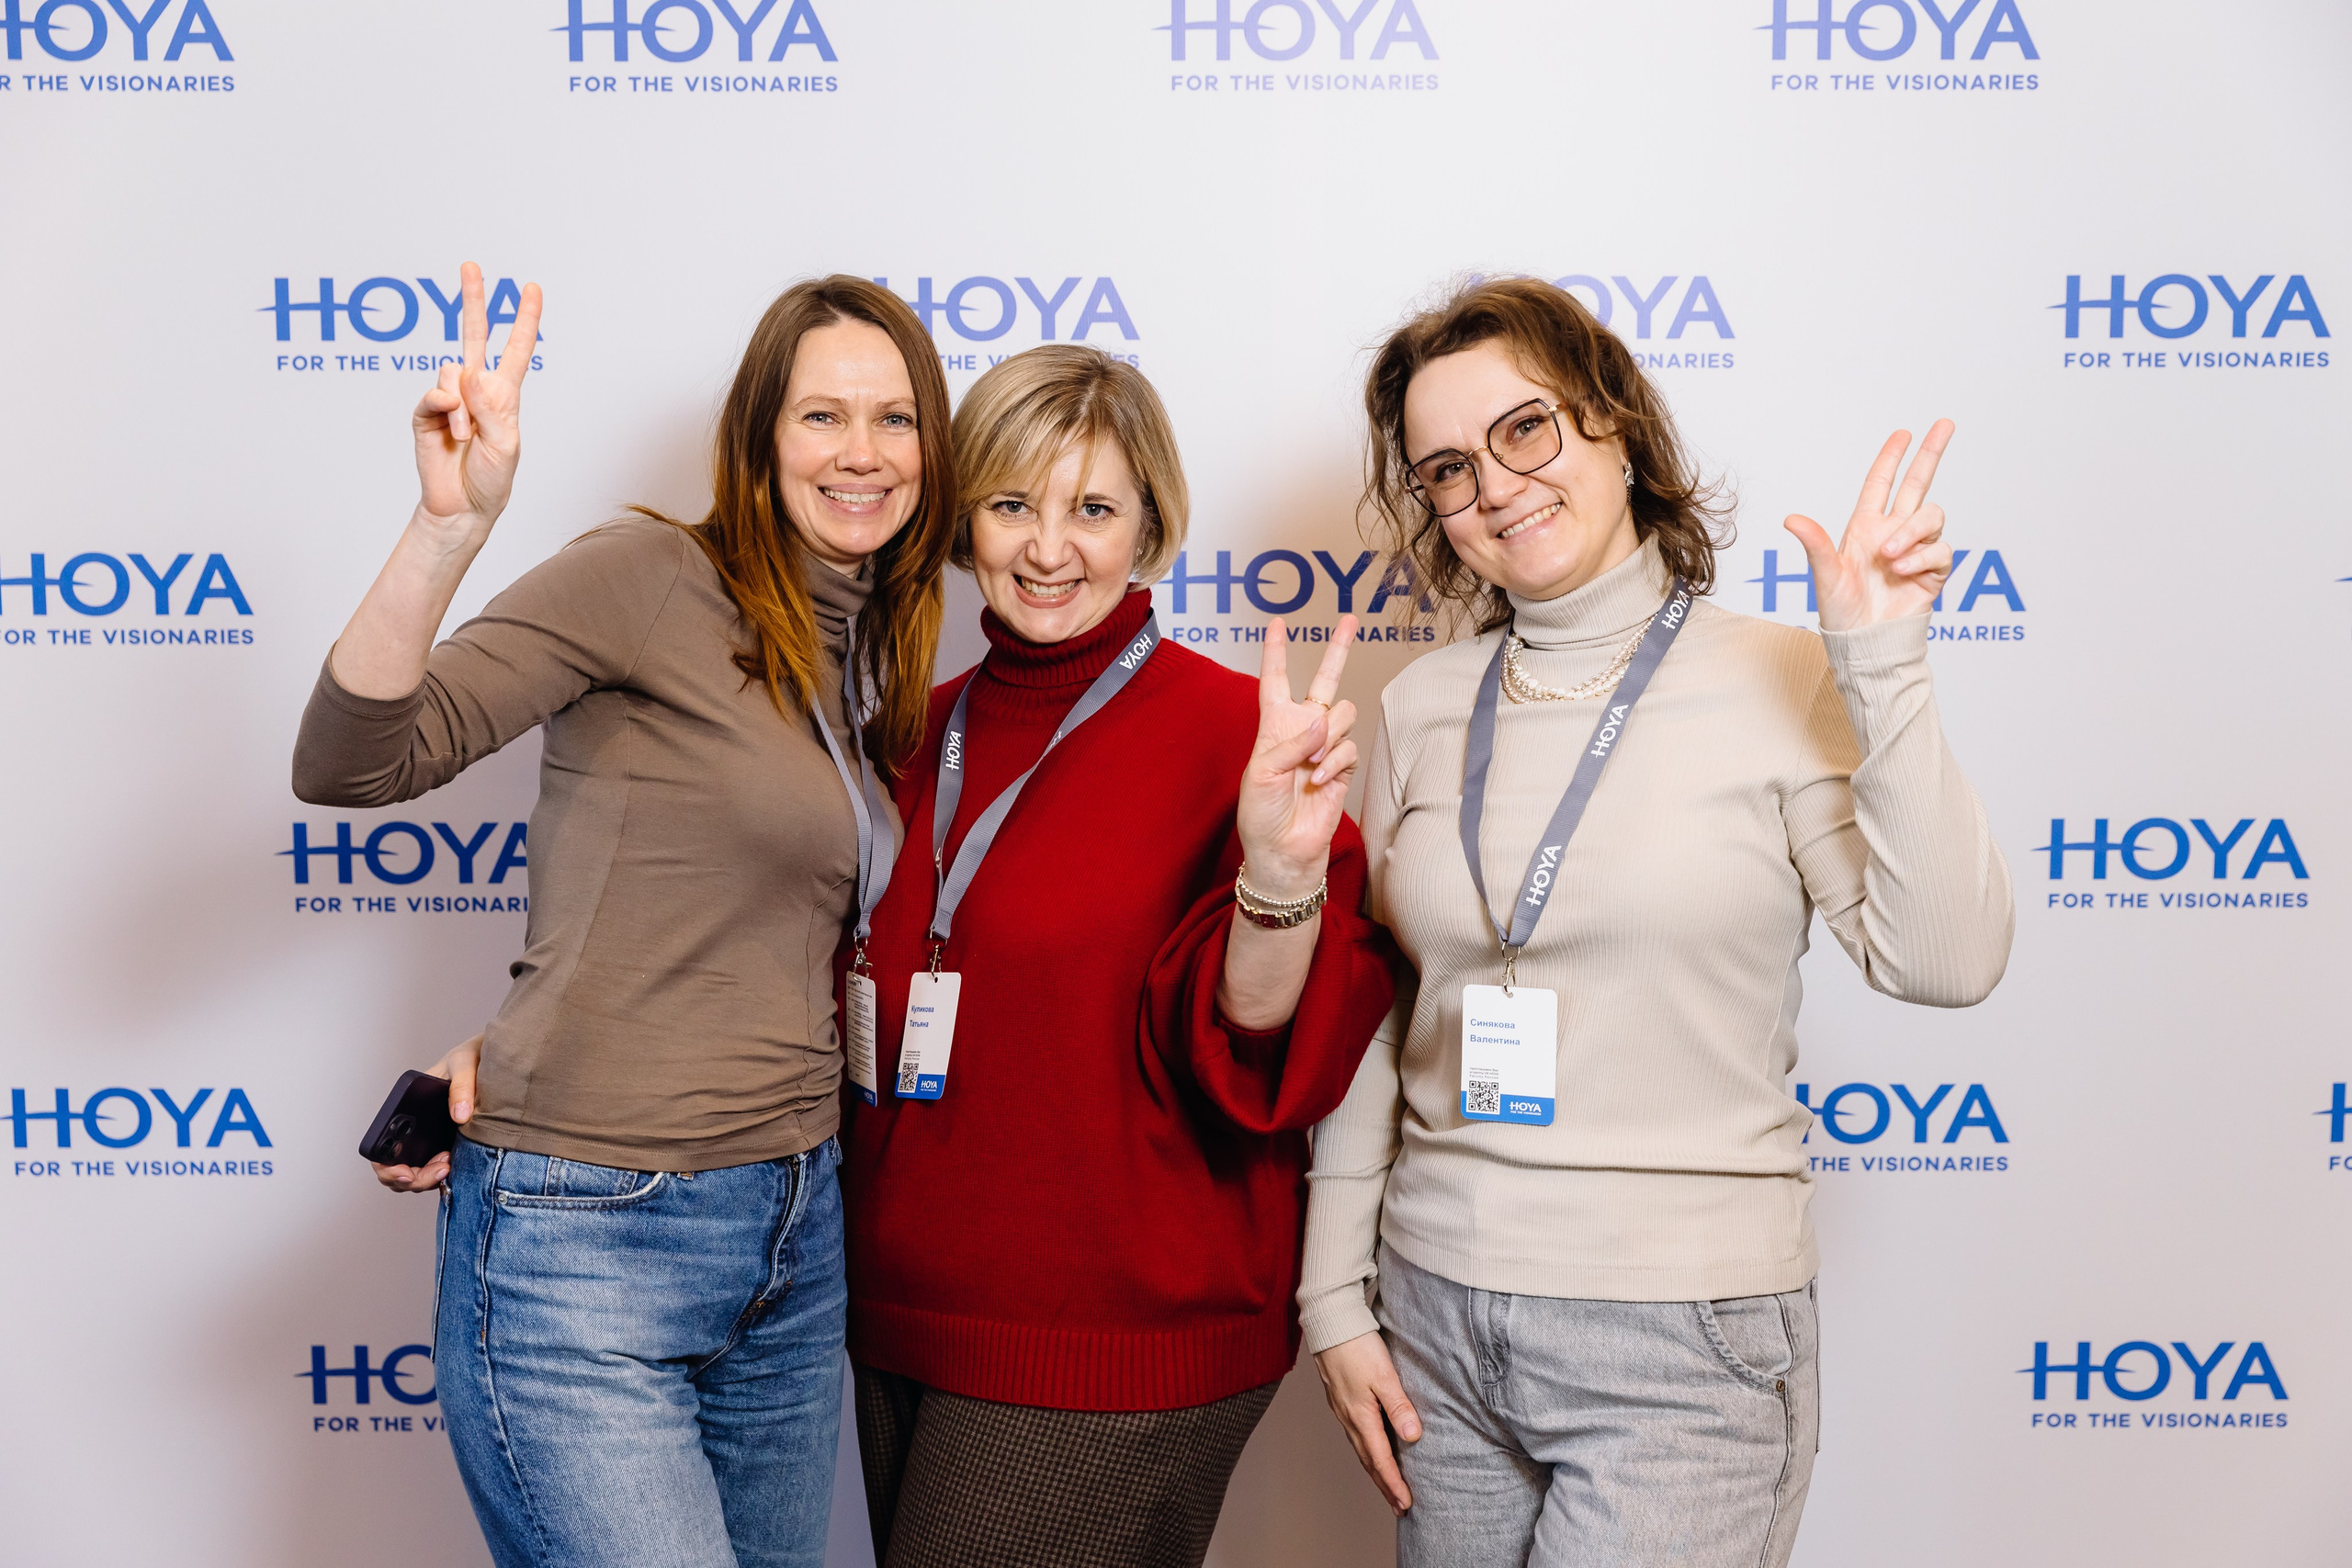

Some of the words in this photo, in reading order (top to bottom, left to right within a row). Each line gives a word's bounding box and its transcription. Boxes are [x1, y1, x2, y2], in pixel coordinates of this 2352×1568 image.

[552, 0, 838, 62] HOYA
[1151, 0, 1440, 62] HOYA
[1756, 0, 2041, 62] HOYA
[24, 75, 68, 91] THE
[80, 75, 234, 92] VISIONARIES
[570, 75, 616, 92] FOR
[628, 76, 673, 92] THE
[684, 75, 838, 92] VISIONARIES
[1171, 75, 1218, 91] FOR
[1230, 75, 1273, 91] THE
[1287, 74, 1439, 90] VISIONARIES
[1771, 75, 1818, 90] FOR
[1830, 74, 1874, 90] THE
[1886, 74, 2040, 90] VISIONARIES
[257, 276, 544, 343] HOYA
[1470, 274, 1736, 340] OYA
[2045, 274, 2331, 339] HOYA
[277, 355, 324, 371] FOR
[335, 355, 379, 371] THE
[1634, 353, 1736, 368] ONARIES
[2064, 353, 2111, 367] FOR
[2123, 352, 2166, 367] THE
[2178, 352, 2330, 367] VISIONARIES
[1157, 548, 1435, 615] HOYA
[1744, 549, 2027, 613] HA
[1661, 590, 1690, 630] HOYA
[0, 630, 36, 645] OR
[48, 630, 91, 645] THE
[103, 629, 254, 645] VISIONARIES
[1171, 626, 1219, 643] FOR
[1229, 626, 1267, 643] TH
[1286, 626, 1436, 643] VISINARIES
[1927, 625, 2026, 642] ONARIES
[1119, 633, 1153, 671] HOYA
[1590, 704, 1629, 758] HOYA
[944, 730, 962, 771] HOYA
[276, 821, 527, 886] HOYA
[2031, 818, 2310, 881] HOYA
[1525, 844, 1562, 908] HOYA
[295, 897, 342, 912] FOR
[353, 897, 397, 912] THE
[407, 897, 528, 912] VISIONARI
[2048, 894, 2094, 908] FOR
[2107, 893, 2148, 908] THE
[2160, 893, 2309, 908] VISIONARIES
[1470, 1019, 1516, 1030] Синякова
[1470, 1034, 1521, 1045] Валентина
[921, 1080, 938, 1089] HOYA
[1510, 1101, 1542, 1113] HOYA
[0, 1088, 273, 1149] HOYA
[15, 1162, 61, 1177] FOR
[73, 1162, 115, 1177] THE
[126, 1161, 273, 1176] VISIONARIES
[1861, 1156, 2008, 1171] VISIONARIES
[294, 1343, 438, 1405] HO
[2017, 1340, 2289, 1401] HOYA
[313, 1416, 359, 1432] FOR
[369, 1416, 413, 1432] THE
[2031, 1413, 2077, 1427] FOR
[2089, 1413, 2131, 1427] THE
[2142, 1413, 2289, 1428] VISIONARIES
